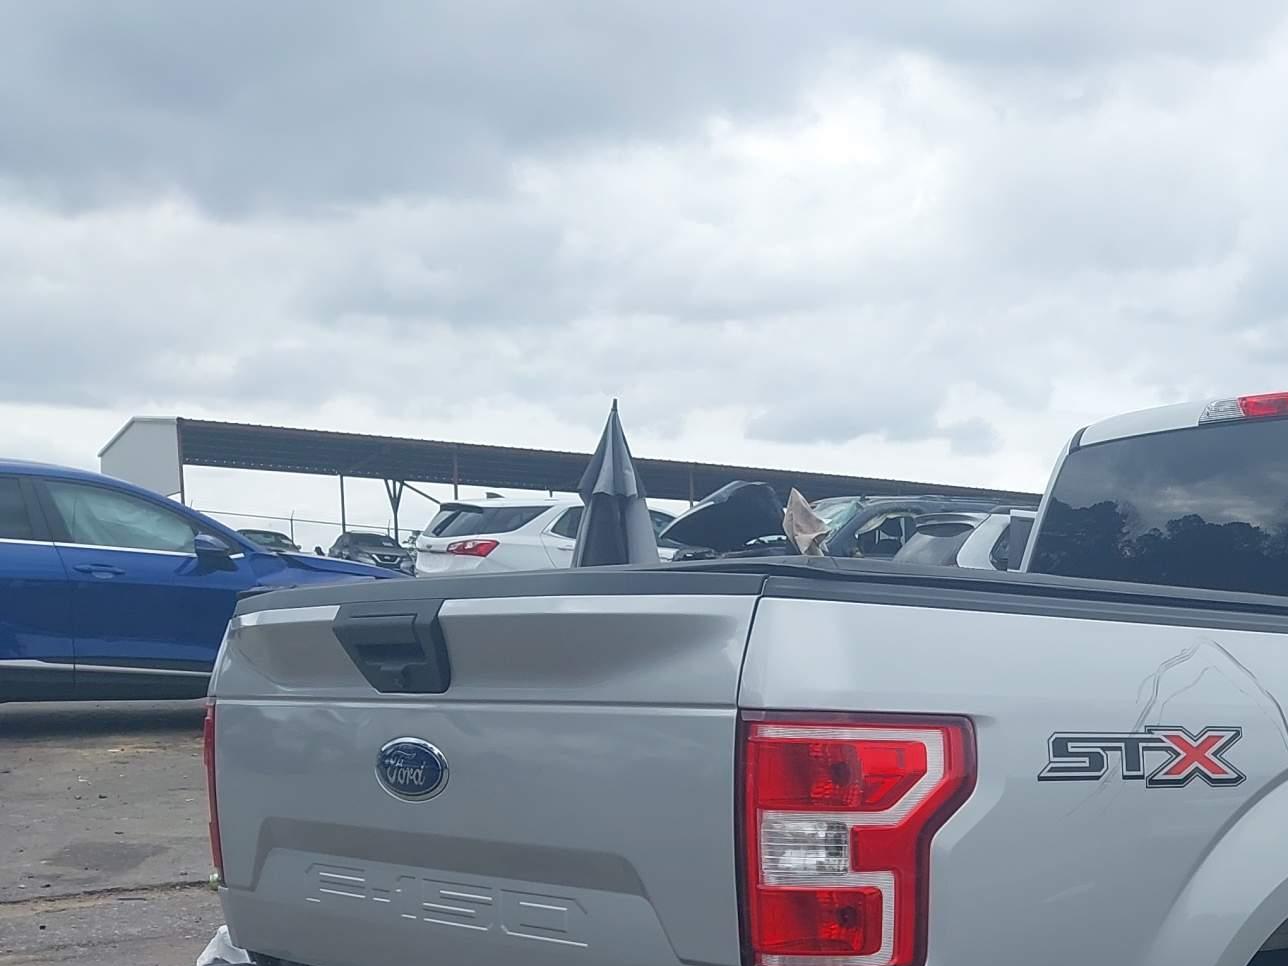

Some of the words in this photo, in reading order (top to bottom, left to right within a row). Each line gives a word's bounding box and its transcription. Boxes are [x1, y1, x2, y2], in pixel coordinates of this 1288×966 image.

[385, 750, 426, 785] Ford
[1038, 726, 1246, 788] STX
[305, 863, 588, 948] F-150
